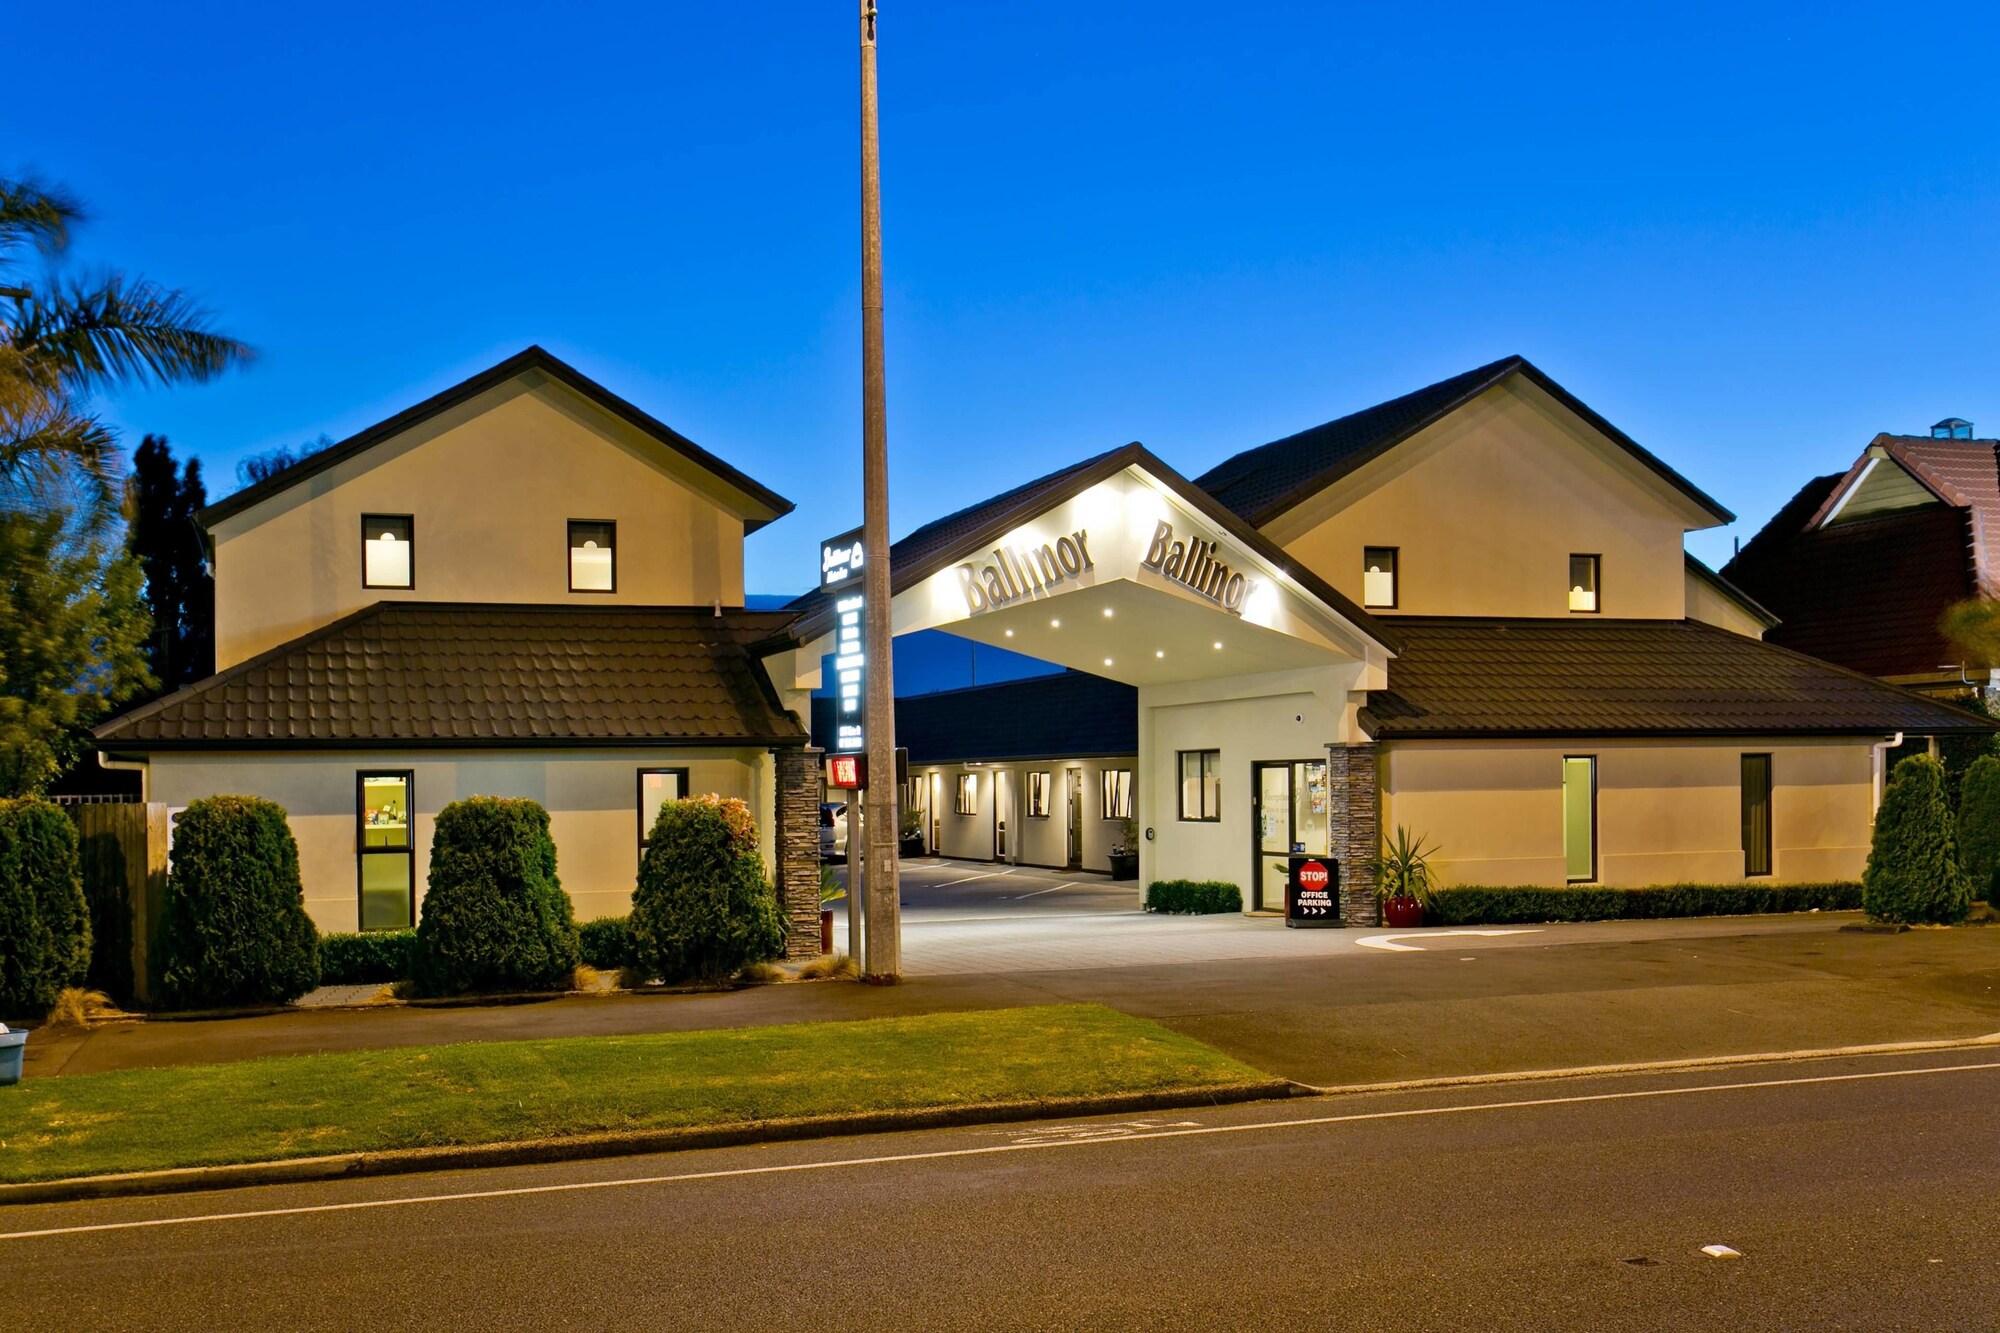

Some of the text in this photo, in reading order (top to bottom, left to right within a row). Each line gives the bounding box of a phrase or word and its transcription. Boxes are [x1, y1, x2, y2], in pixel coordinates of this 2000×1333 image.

[957, 529, 1095, 616] Ballinor
[1300, 871, 1328, 882] STOP!
[1301, 891, 1329, 899] OFFICE
[1297, 899, 1332, 907] PARKING
